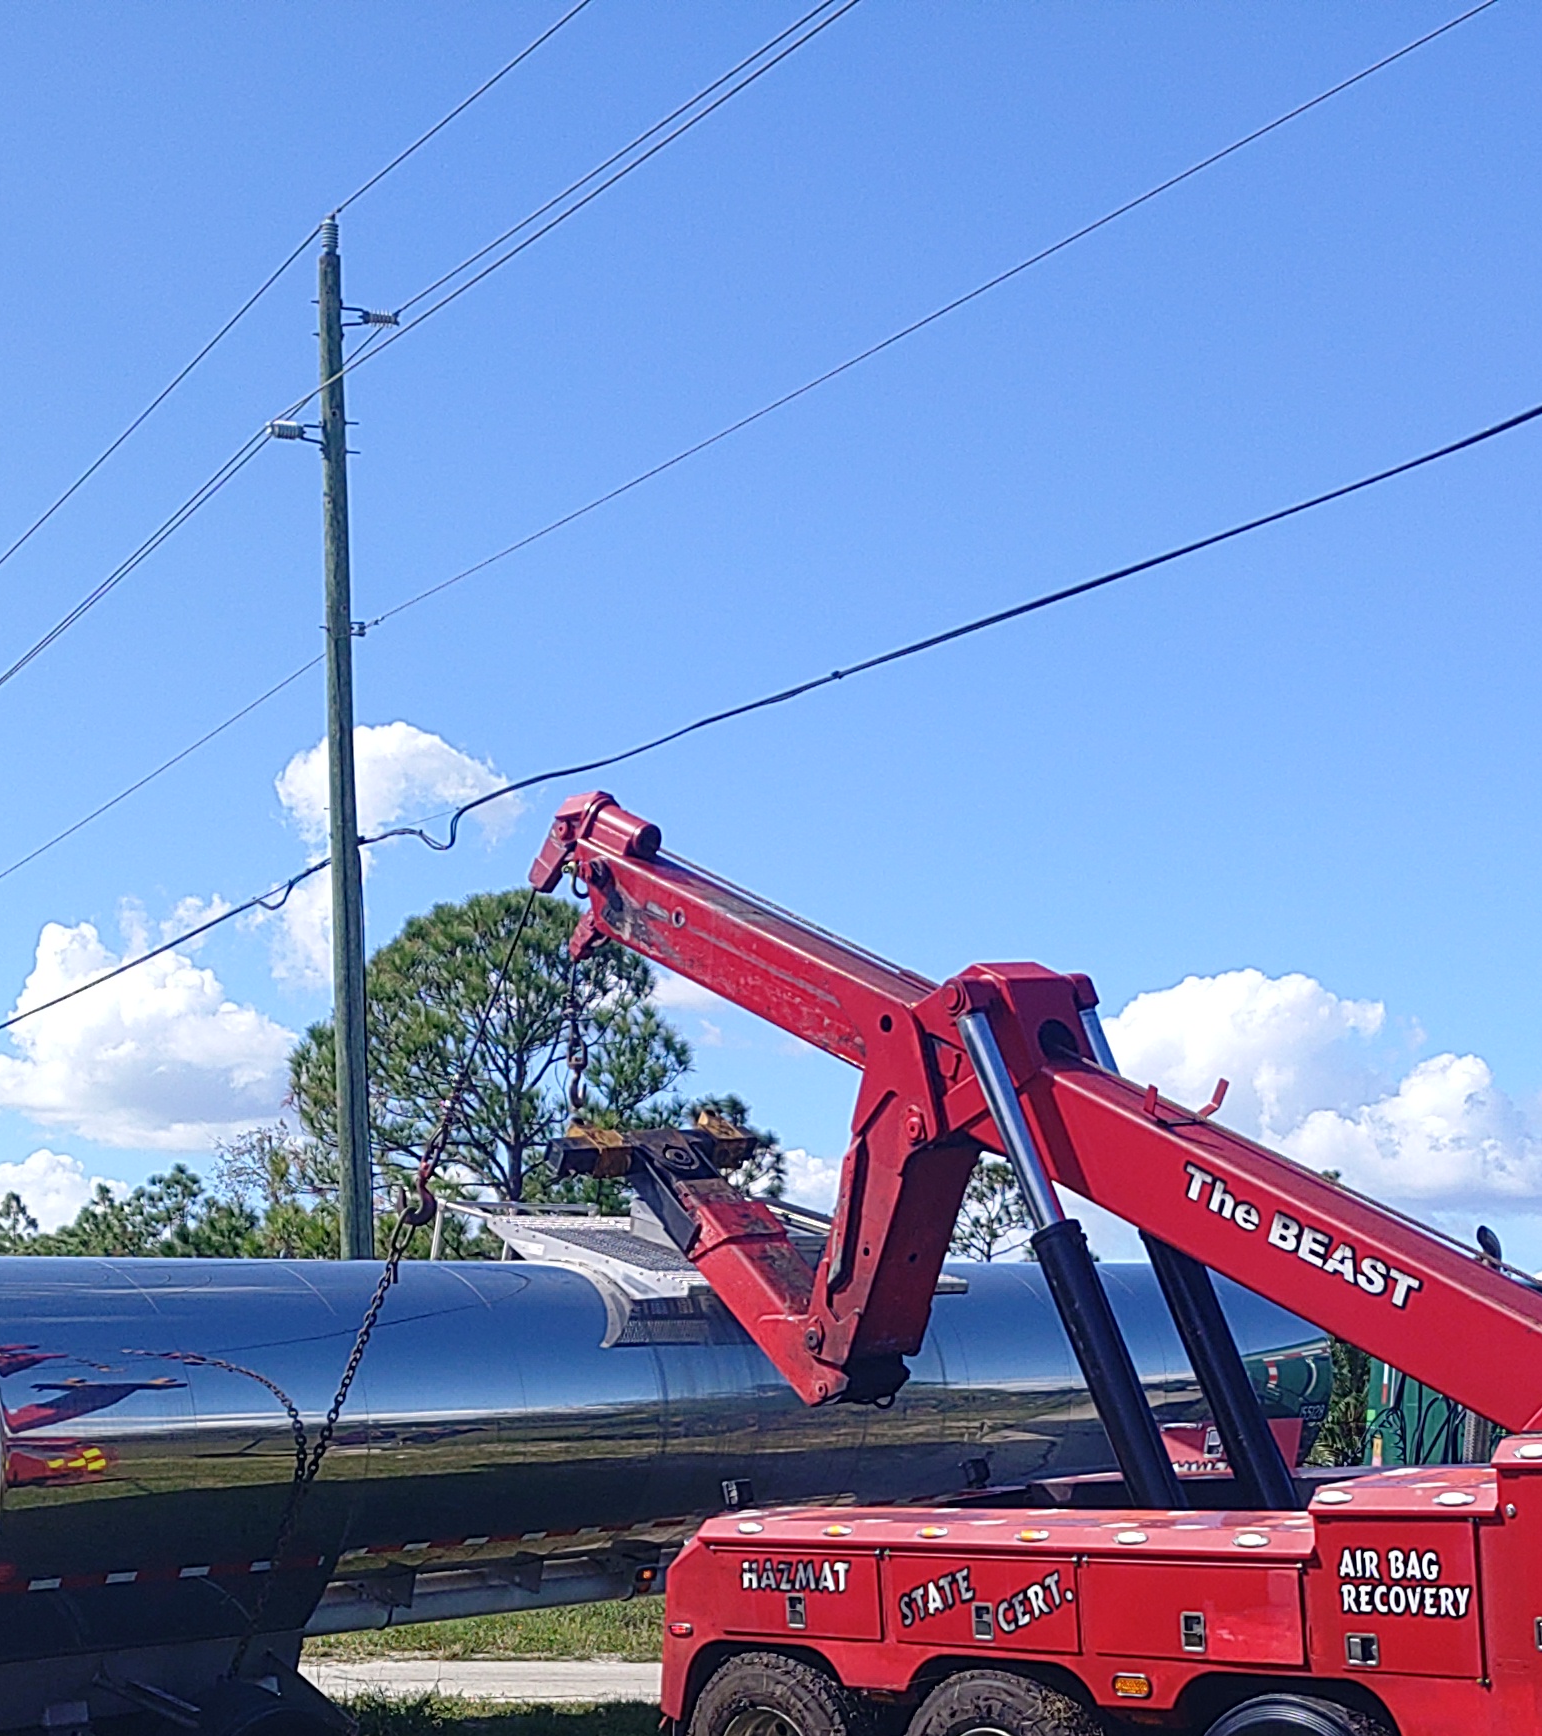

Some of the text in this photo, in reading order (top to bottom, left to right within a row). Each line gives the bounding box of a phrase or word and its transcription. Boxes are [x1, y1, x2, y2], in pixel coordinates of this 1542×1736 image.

[1184, 1162, 1421, 1308] The BEAST
[741, 1560, 851, 1594] HAZMAT
[1339, 1547, 1440, 1582] AIR BAG
[899, 1567, 1075, 1634] STATE CERT.
[1341, 1584, 1472, 1618] RECOVERY
